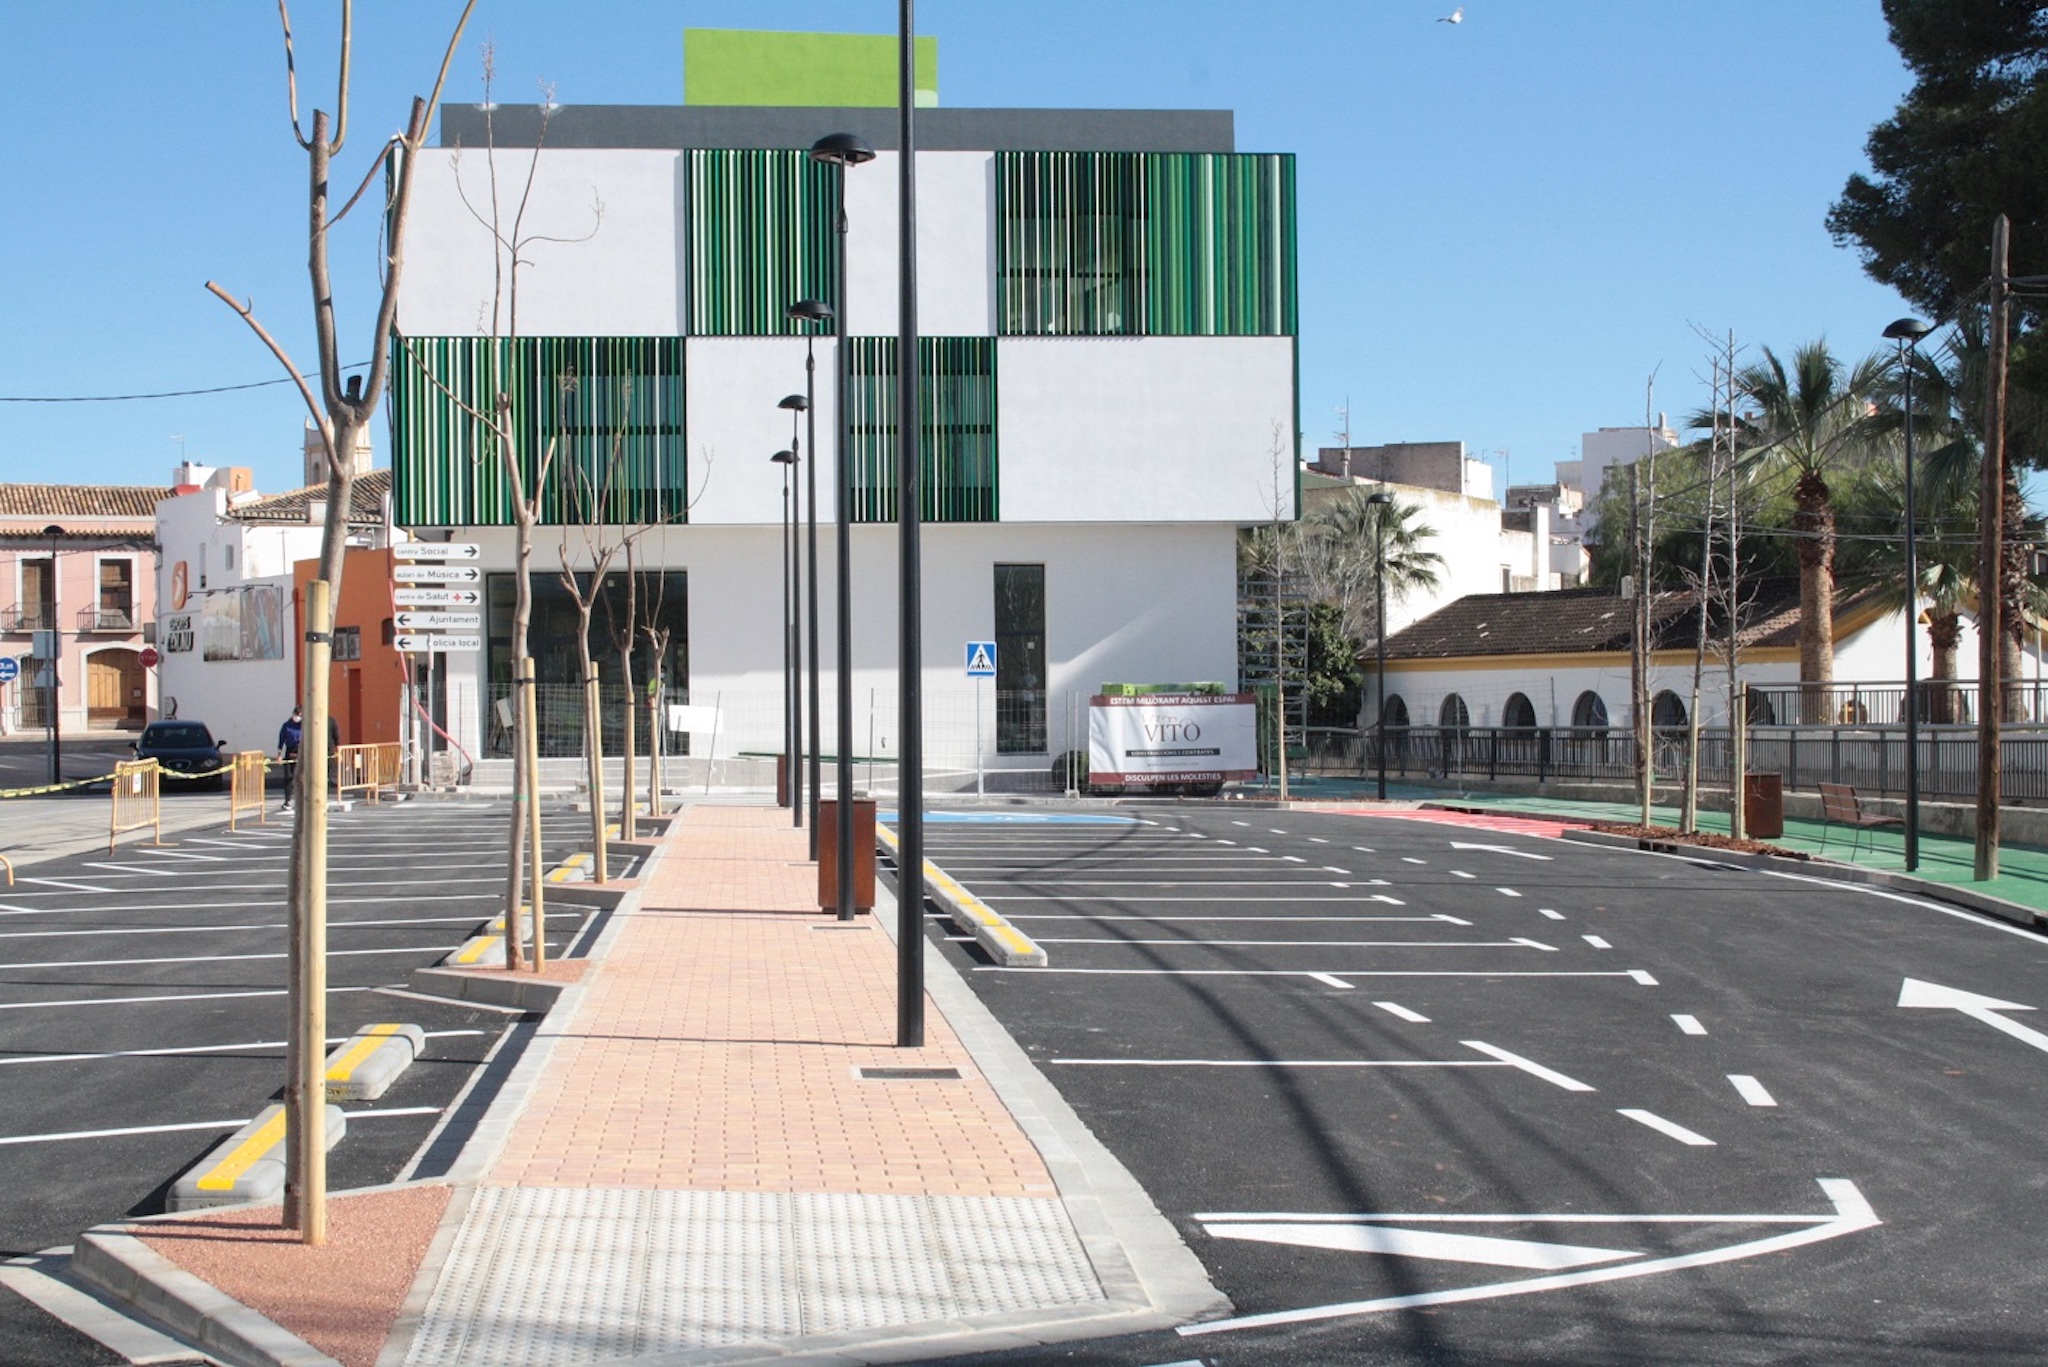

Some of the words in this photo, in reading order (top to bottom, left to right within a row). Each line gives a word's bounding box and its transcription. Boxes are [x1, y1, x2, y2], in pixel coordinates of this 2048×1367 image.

[421, 547, 448, 555] Social
[427, 569, 460, 578] Música
[425, 592, 449, 600] Salut
[429, 616, 479, 624] Ajuntament
[459, 639, 479, 647] local
[1110, 697, 1135, 705] ESTEM
[1136, 697, 1180, 705] MILLORANT
[1181, 696, 1212, 704] AQUEST
[1166, 773, 1179, 781] LES
[1180, 772, 1222, 781] MOLESTIES
